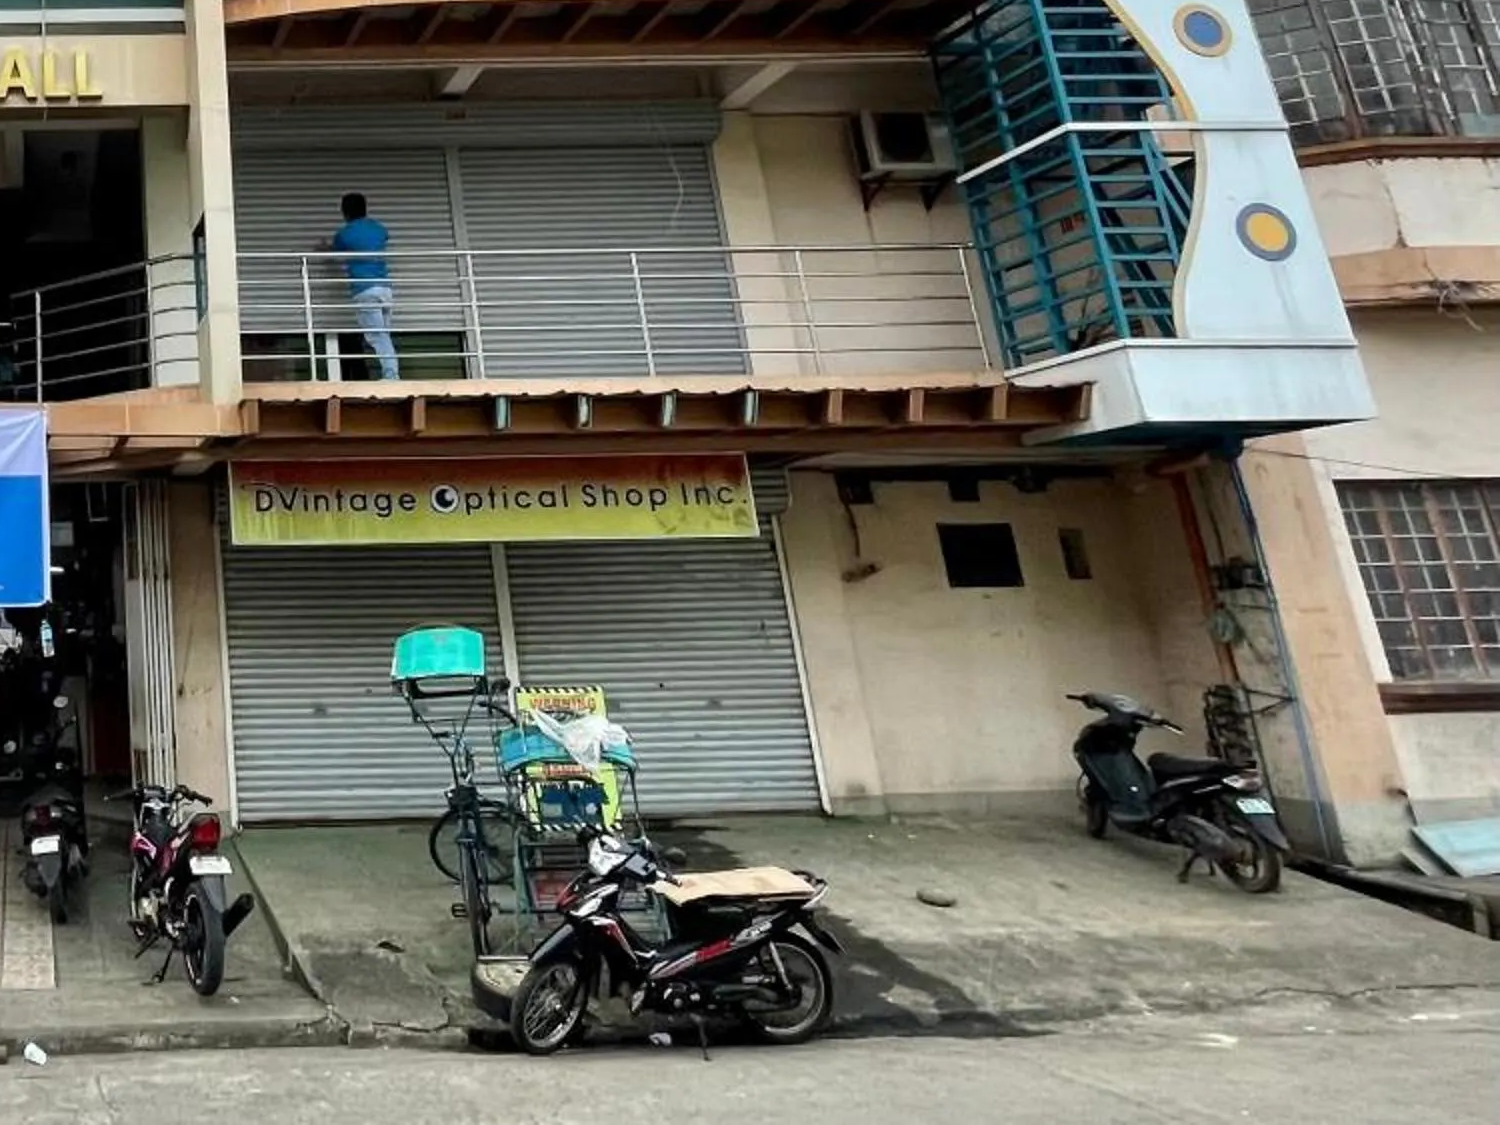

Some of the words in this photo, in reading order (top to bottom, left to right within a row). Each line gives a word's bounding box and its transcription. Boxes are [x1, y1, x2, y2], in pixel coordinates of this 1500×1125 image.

[255, 486, 416, 518] DVintage
[430, 483, 568, 515] Optical
[582, 482, 668, 509] Shop
[682, 481, 748, 506] Inc.
